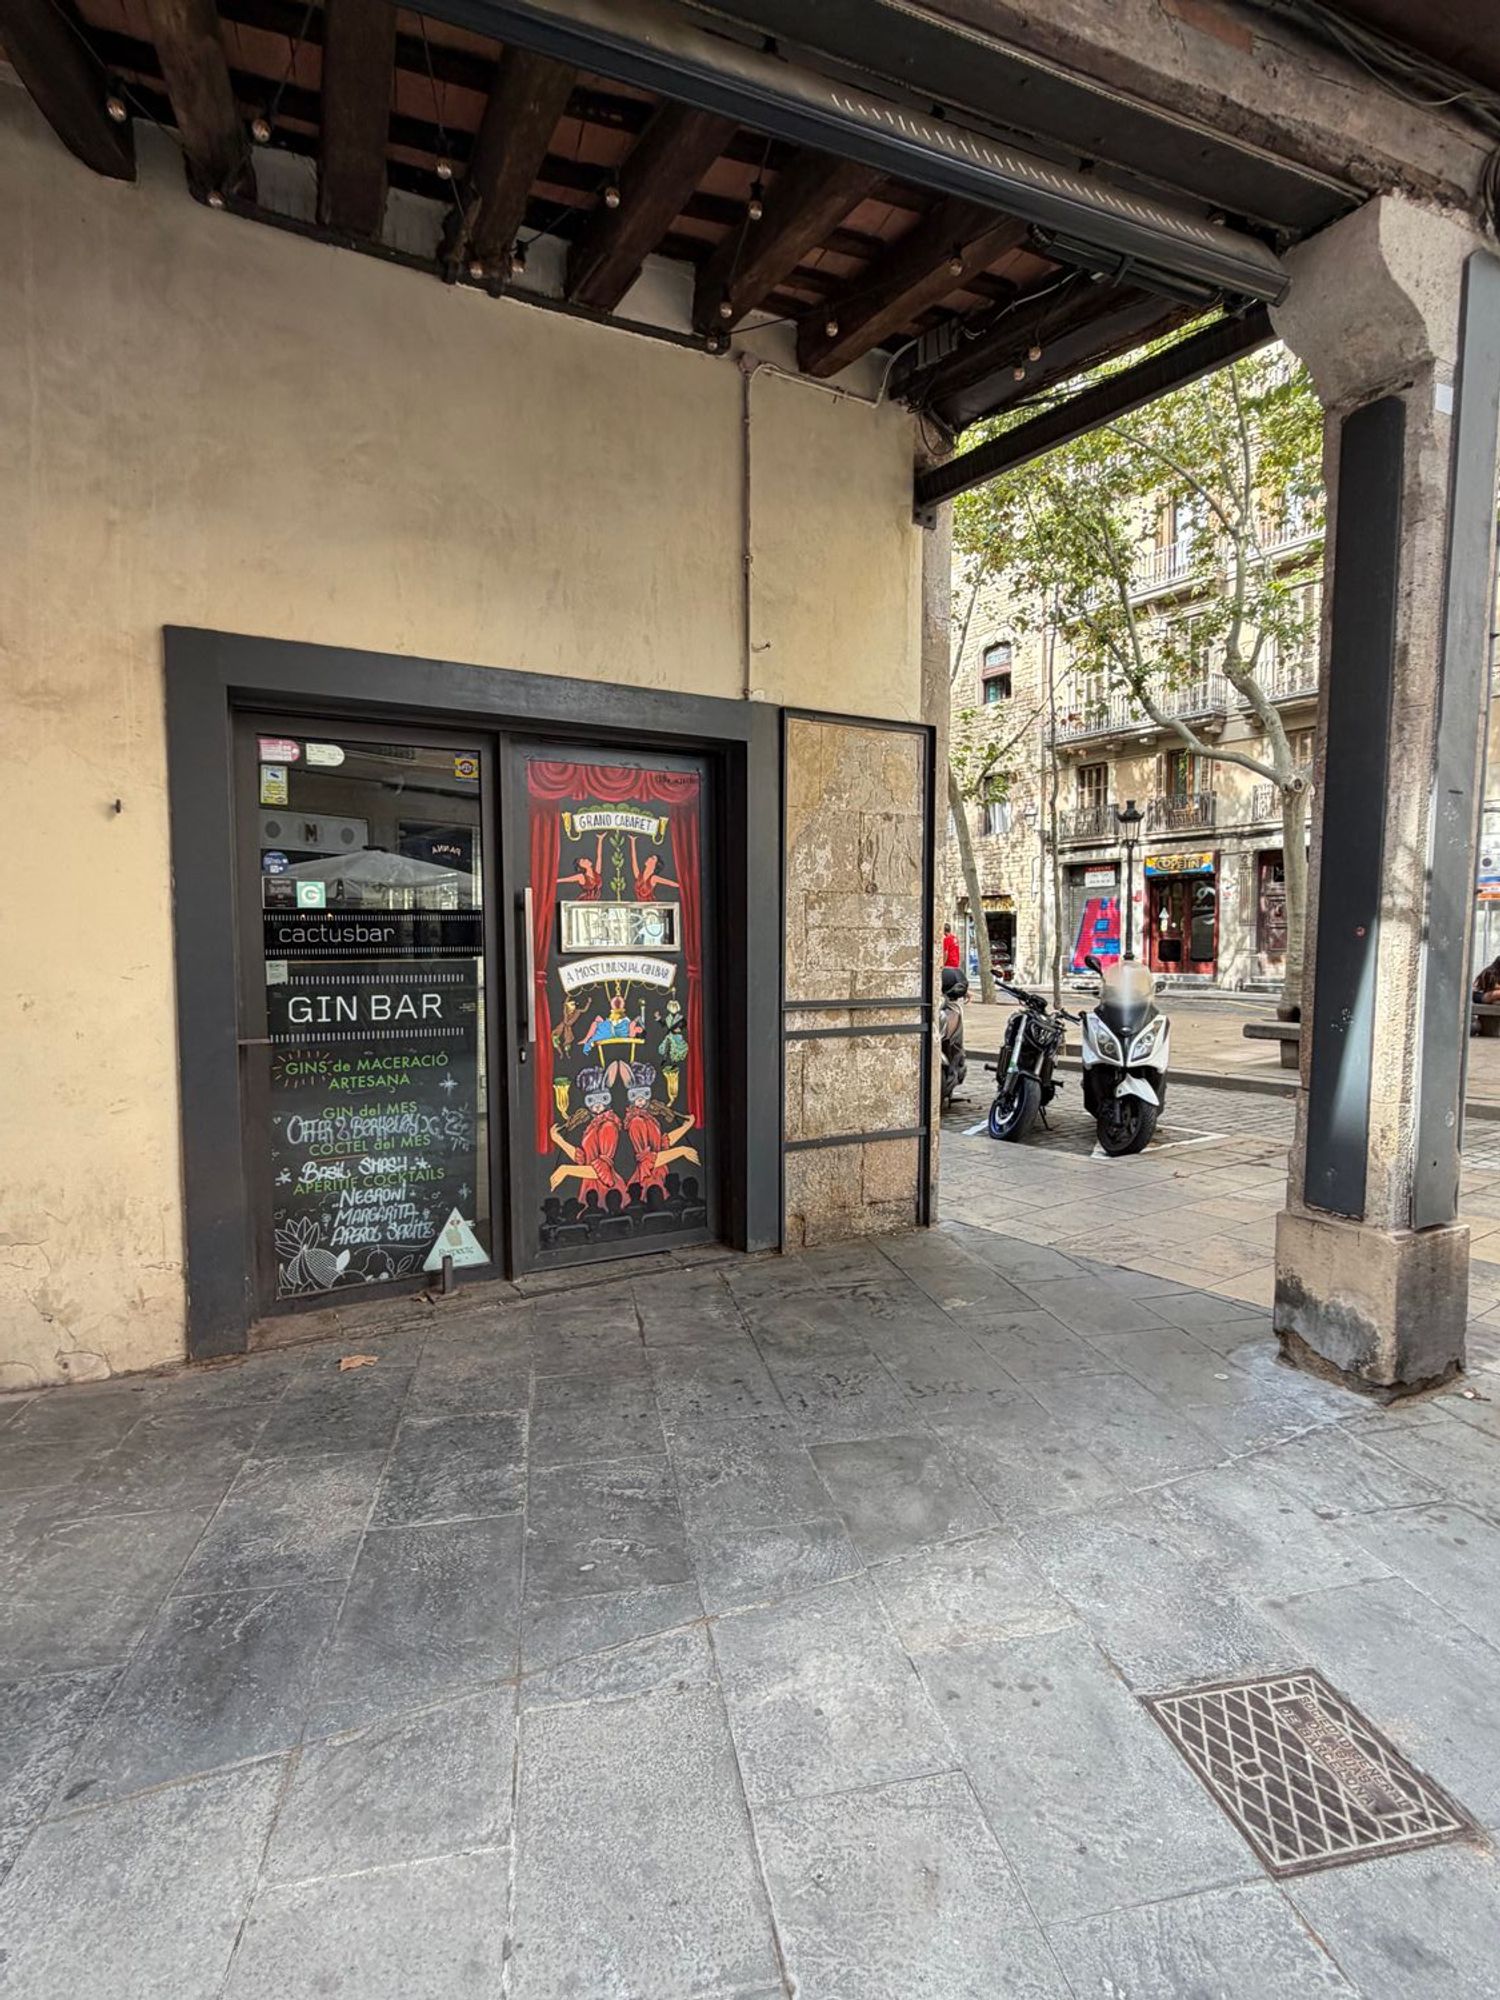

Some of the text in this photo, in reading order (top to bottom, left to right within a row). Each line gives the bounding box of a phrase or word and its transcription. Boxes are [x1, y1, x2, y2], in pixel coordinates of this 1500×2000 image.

[579, 814, 652, 831] GRAND CABARET
[279, 923, 395, 943] cactusbar
[575, 963, 600, 980] MOST
[288, 993, 443, 1023] GIN BAR
[285, 1051, 449, 1075] GINS de MACERACIÓ
[328, 1073, 411, 1090] ARTESANA
[322, 1101, 418, 1119] GIN del MES
[308, 1134, 431, 1156] COCTEL del MES
[363, 1167, 445, 1187] COCKTAILS
[1306, 1720, 1327, 1738] DE
[1278, 1706, 1375, 1806] DE BARCELONA
[1301, 1695, 1411, 1811] SOCIEDAD GENERAL
